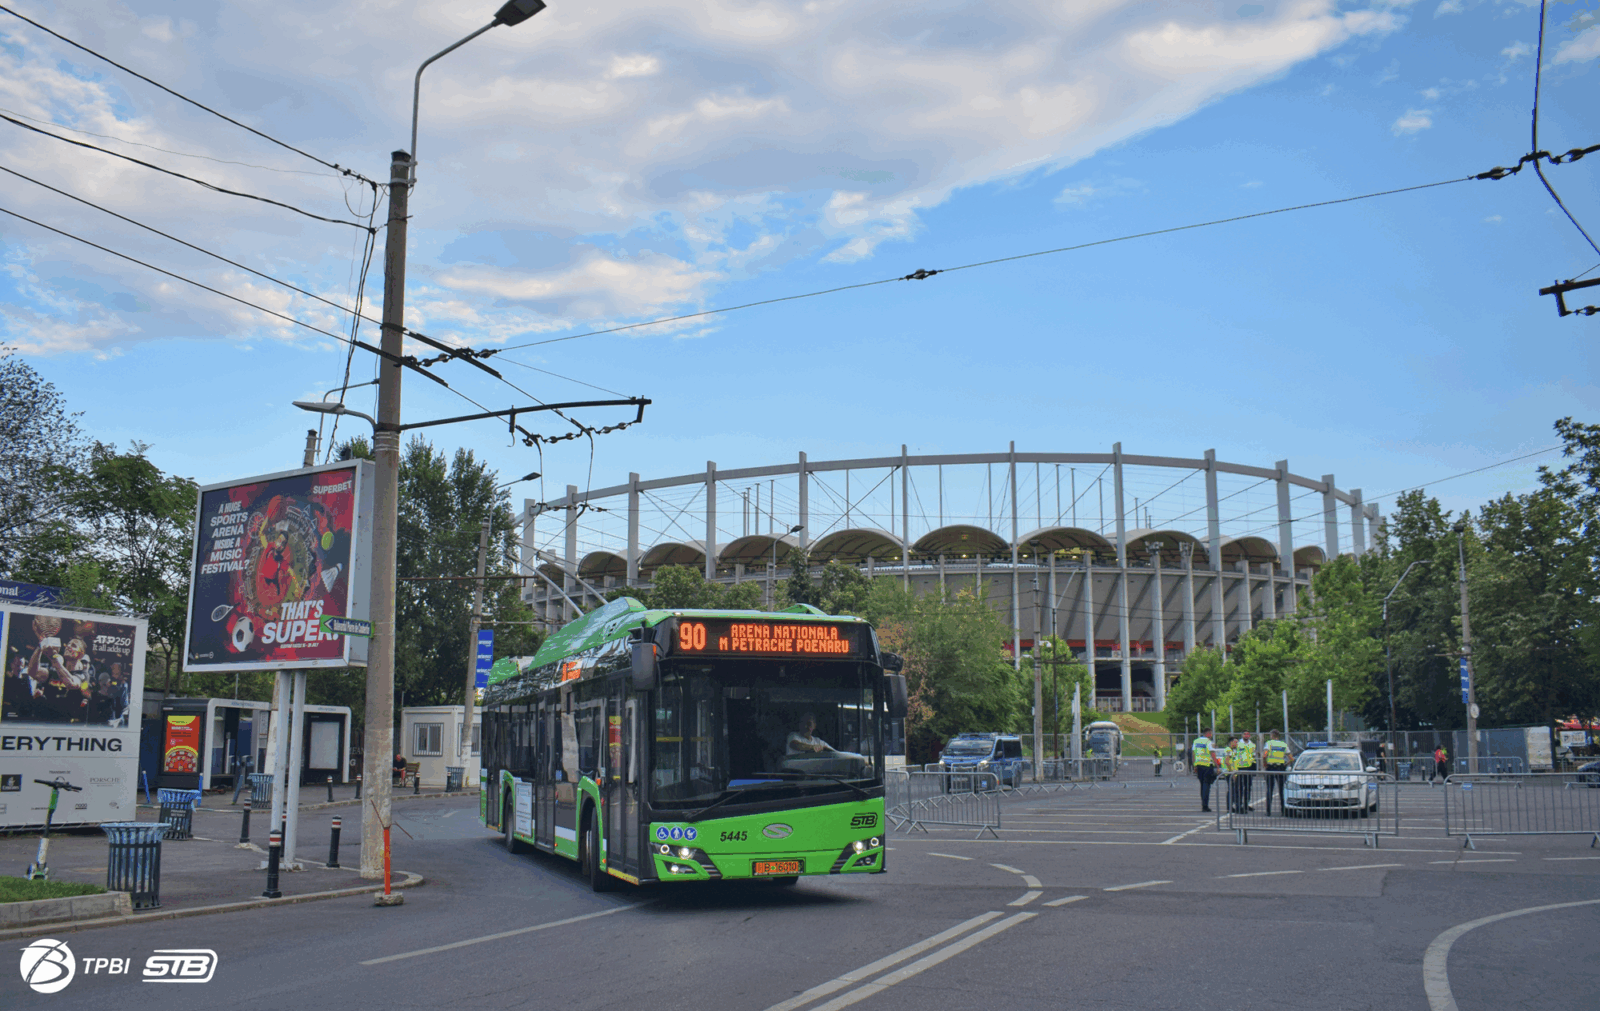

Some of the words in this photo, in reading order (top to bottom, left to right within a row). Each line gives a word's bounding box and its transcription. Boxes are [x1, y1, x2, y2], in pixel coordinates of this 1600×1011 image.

[313, 480, 352, 494] SUPERBET
[218, 503, 224, 514] A
[224, 501, 241, 512] HUGE
[210, 512, 248, 527] SPORTS
[212, 524, 244, 538] ARENA
[213, 538, 234, 550] INSIDE
[234, 537, 241, 548] A
[210, 548, 242, 562] MUSIC
[201, 560, 249, 575] FESTIVAL?
[281, 600, 324, 620] THAT'S
[680, 622, 706, 650] 90
[731, 624, 770, 638] ARENA
[774, 625, 838, 640] NATIONALA
[92, 643, 98, 651] It
[98, 644, 106, 652] all
[107, 645, 121, 653] adds
[122, 648, 131, 656] up
[719, 637, 728, 650] M
[732, 638, 793, 652] PETRACHE
[797, 639, 849, 653] POENARU
[0, 736, 122, 752] ERYTHING
[850, 814, 877, 827] STB
[720, 830, 748, 842] 5445
